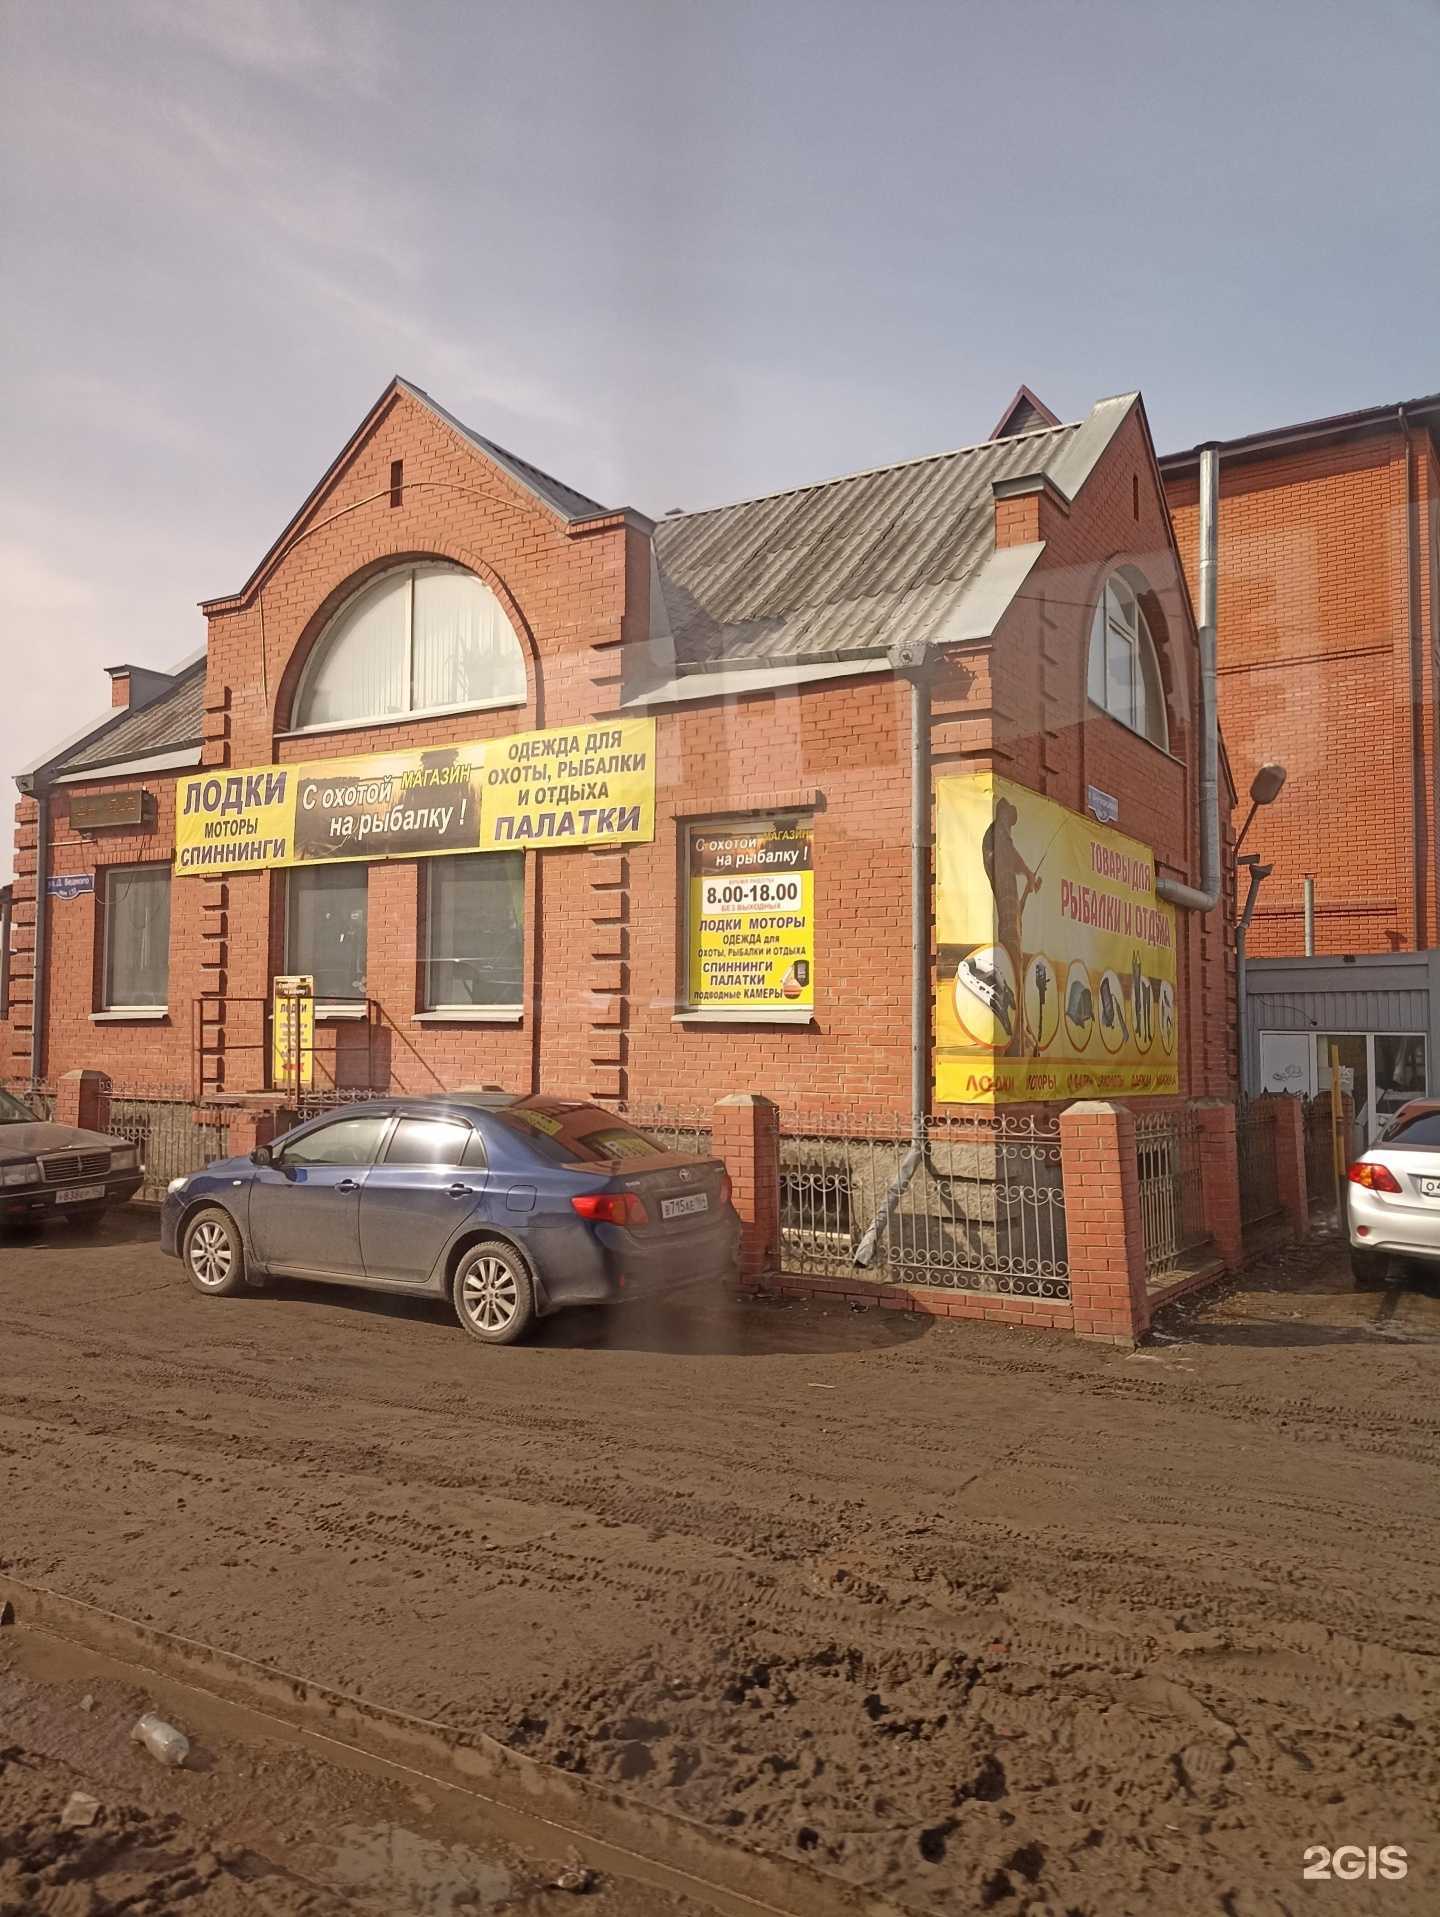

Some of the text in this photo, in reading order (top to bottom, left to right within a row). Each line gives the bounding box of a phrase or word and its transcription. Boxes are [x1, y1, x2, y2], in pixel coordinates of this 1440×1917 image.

[508, 730, 622, 762] ОДЕЖДА ДЛЯ
[401, 763, 472, 790] МАГАЗИН
[488, 753, 646, 786] ОХОТЫ, РЫБАЛКИ
[184, 771, 287, 816] ЛОДКИ
[303, 775, 392, 810] С охотой
[518, 782, 609, 806] И ОТДЫХА
[205, 818, 258, 839] МОТОРЫ
[330, 815, 357, 836] на
[358, 803, 453, 840] рыбалку
[494, 806, 641, 841] ПАЛАТКИ
[181, 838, 286, 866] СПИННИНГИ
[696, 838, 705, 852] С
[716, 854, 732, 867] на
[736, 848, 800, 868] рыбалку
[1090, 842, 1151, 892] ТОВАРЫ ДЛЯ
[707, 882, 798, 904] 8.00-18.00
[699, 916, 805, 932] ЛОДКИ МОТОРЫ
[1062, 879, 1170, 948] РЫБАЛКИ И ОТДЫХА
[723, 934, 779, 945] ОДЕЖДА для
[728, 948, 764, 957] РЫБАЛКИ
[773, 946, 806, 956] ОТДЫХА
[703, 960, 773, 973] СПИННИНГИ
[710, 974, 765, 986] ПАЛАТКИ
[694, 988, 783, 1001] подводные КАМЕРЫ
